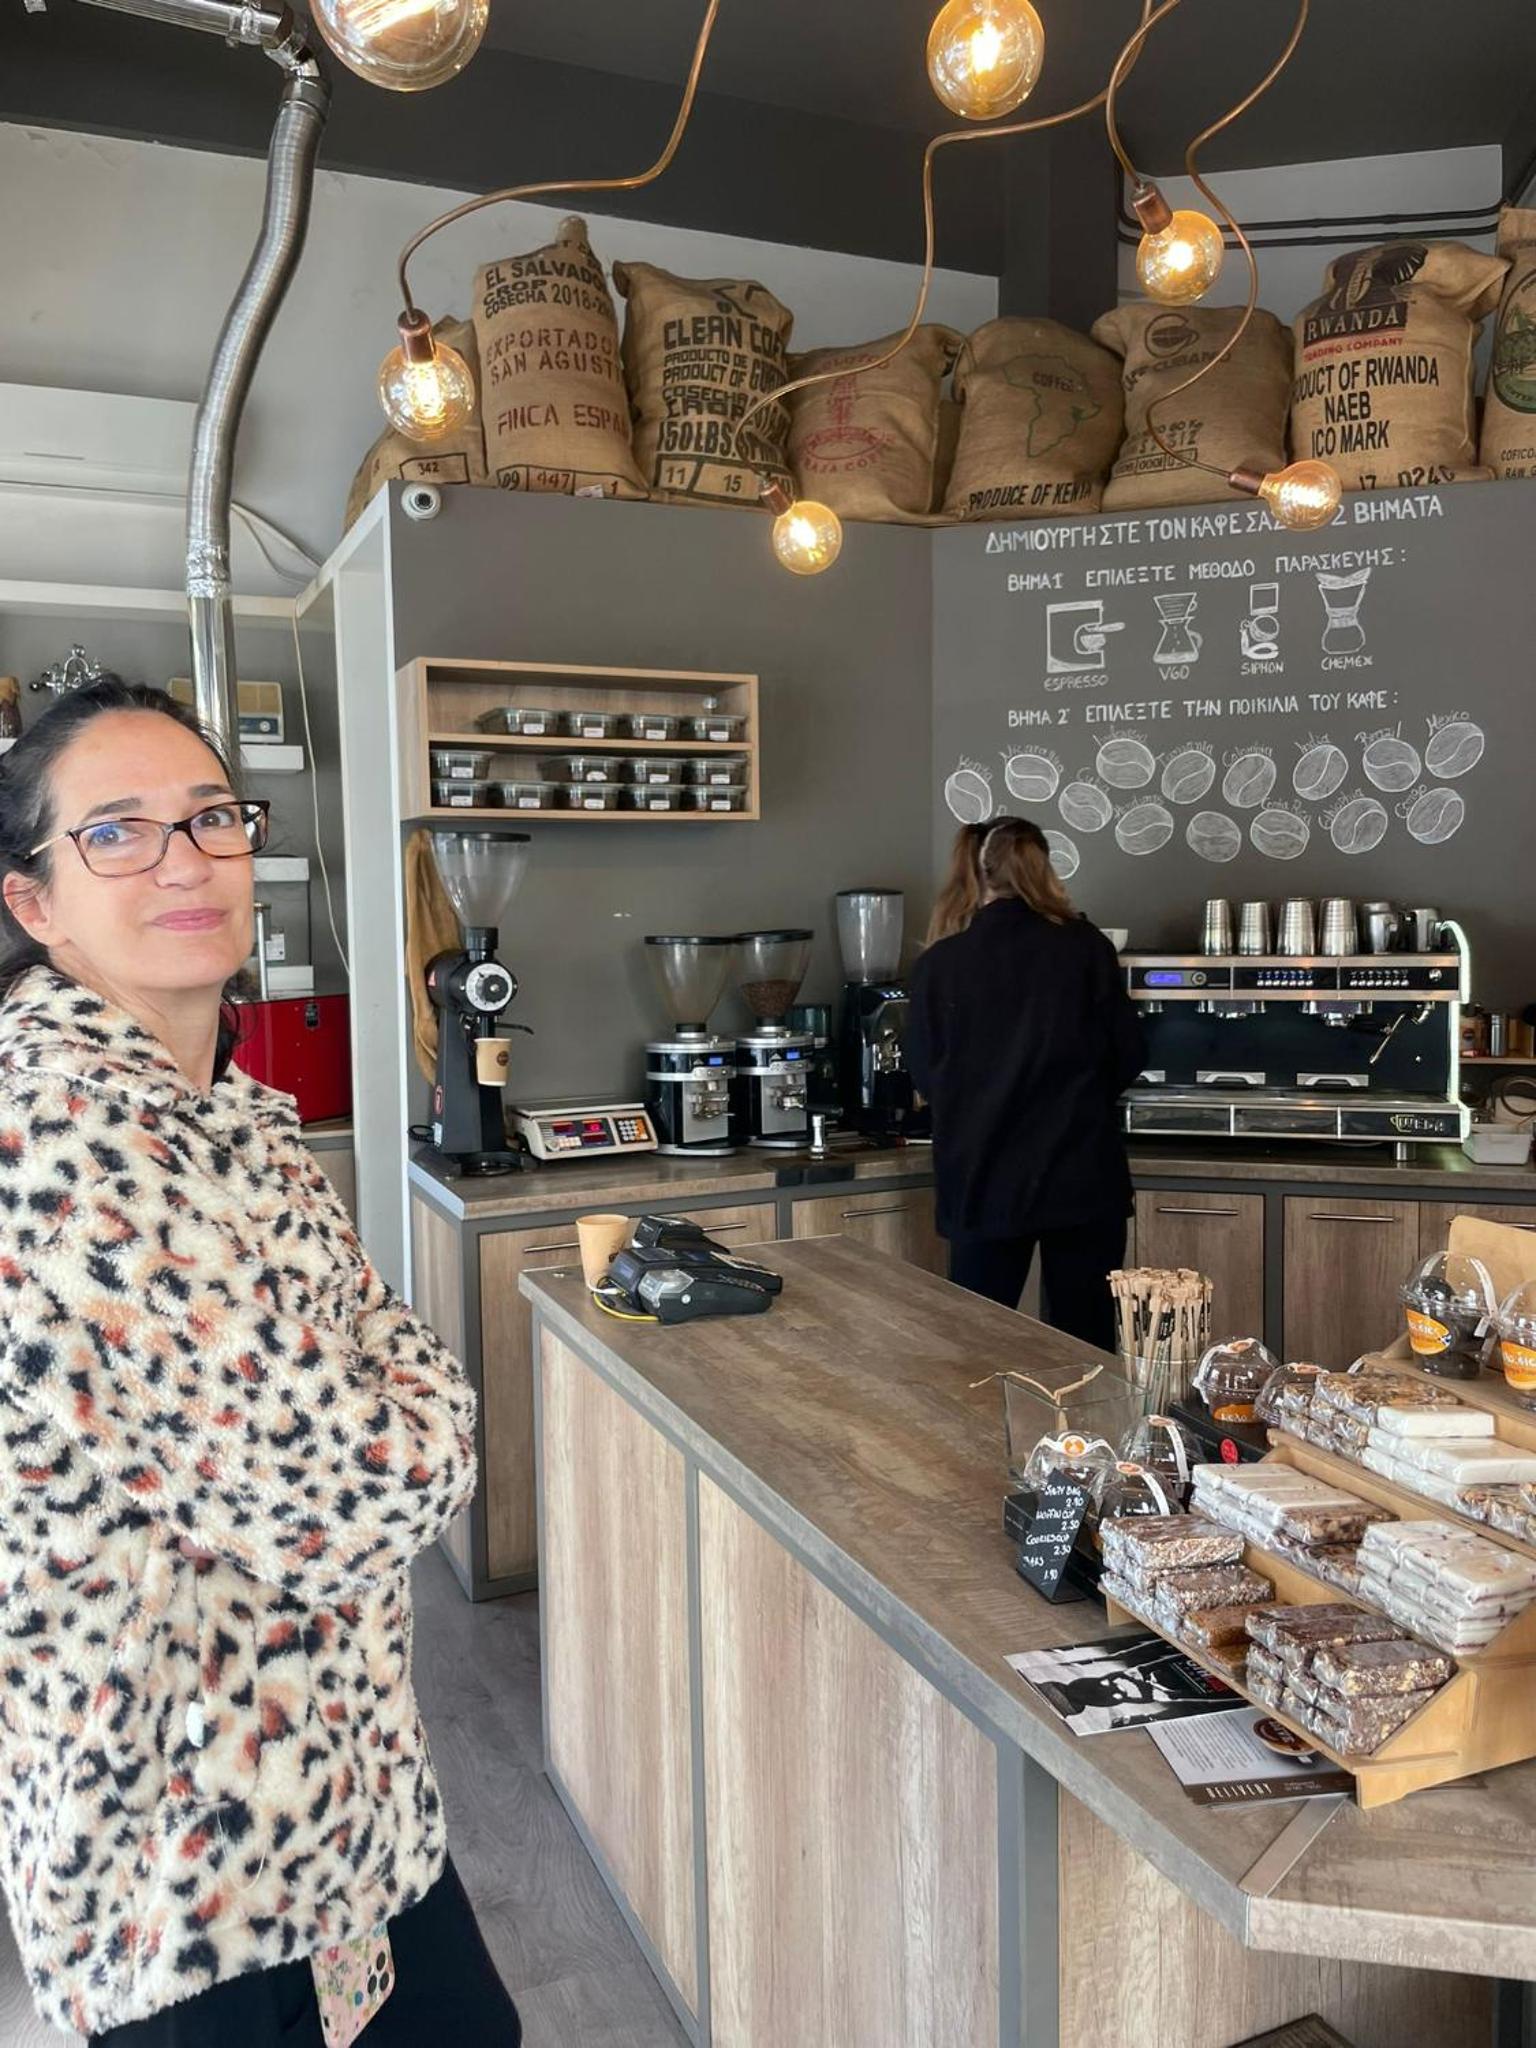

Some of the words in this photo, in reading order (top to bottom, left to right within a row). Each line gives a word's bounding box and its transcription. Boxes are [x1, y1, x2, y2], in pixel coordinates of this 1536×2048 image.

[485, 266, 506, 291] EL
[511, 259, 608, 296] SALVADO
[483, 280, 547, 306] CROP
[484, 290, 547, 320] COSECHA
[663, 315, 743, 351] CLEAN
[1305, 305, 1400, 343] RWANDA
[663, 347, 730, 367] PRODUCTO
[732, 353, 748, 369] DE
[1346, 337, 1404, 354] COMPANY
[490, 351, 527, 387] SAN
[662, 362, 727, 387] PRODUCT
[729, 368, 747, 389] OF
[1338, 360, 1362, 390] OF
[1366, 355, 1439, 388] RWANDA
[661, 384, 749, 404] COSECHA
[1325, 391, 1371, 424] NAEB
[497, 404, 560, 436] FINCA
[666, 398, 746, 421] CROP
[1311, 426, 1336, 458] ICO
[1340, 419, 1390, 454] MARK
[665, 466, 686, 485] 11
[723, 474, 743, 493] 15
[968, 483, 1027, 512] PRODUCE
[1031, 483, 1053, 506] OF
[984, 520, 1141, 554] ΔΗΜΙΟΥΡΓΗΣΤΕ
[1145, 518, 1187, 543] ΤΟΝ
[1190, 512, 1243, 539] ΚΑΦΕ
[1354, 494, 1444, 525] ΒΗΜΑΤΑ
[1085, 564, 1176, 588] ΕΠΙΛΕΞΤΕ
[1188, 558, 1256, 580] ΜΕΘΟΔΟ
[1240, 660, 1284, 676] SIPHON
[1320, 655, 1374, 671] CHEMEX
[1043, 674, 1109, 692] ESPRESSO
[1007, 708, 1052, 729] ΒΗΜΑ
[1085, 700, 1173, 724] ΕΠΙΛΕΞΤΕ
[1182, 699, 1222, 718] ΤΗΝ
[1229, 695, 1299, 717] ΠΟΙΚΙΛΙΑ
[1308, 693, 1341, 712] ΤΟΥ
